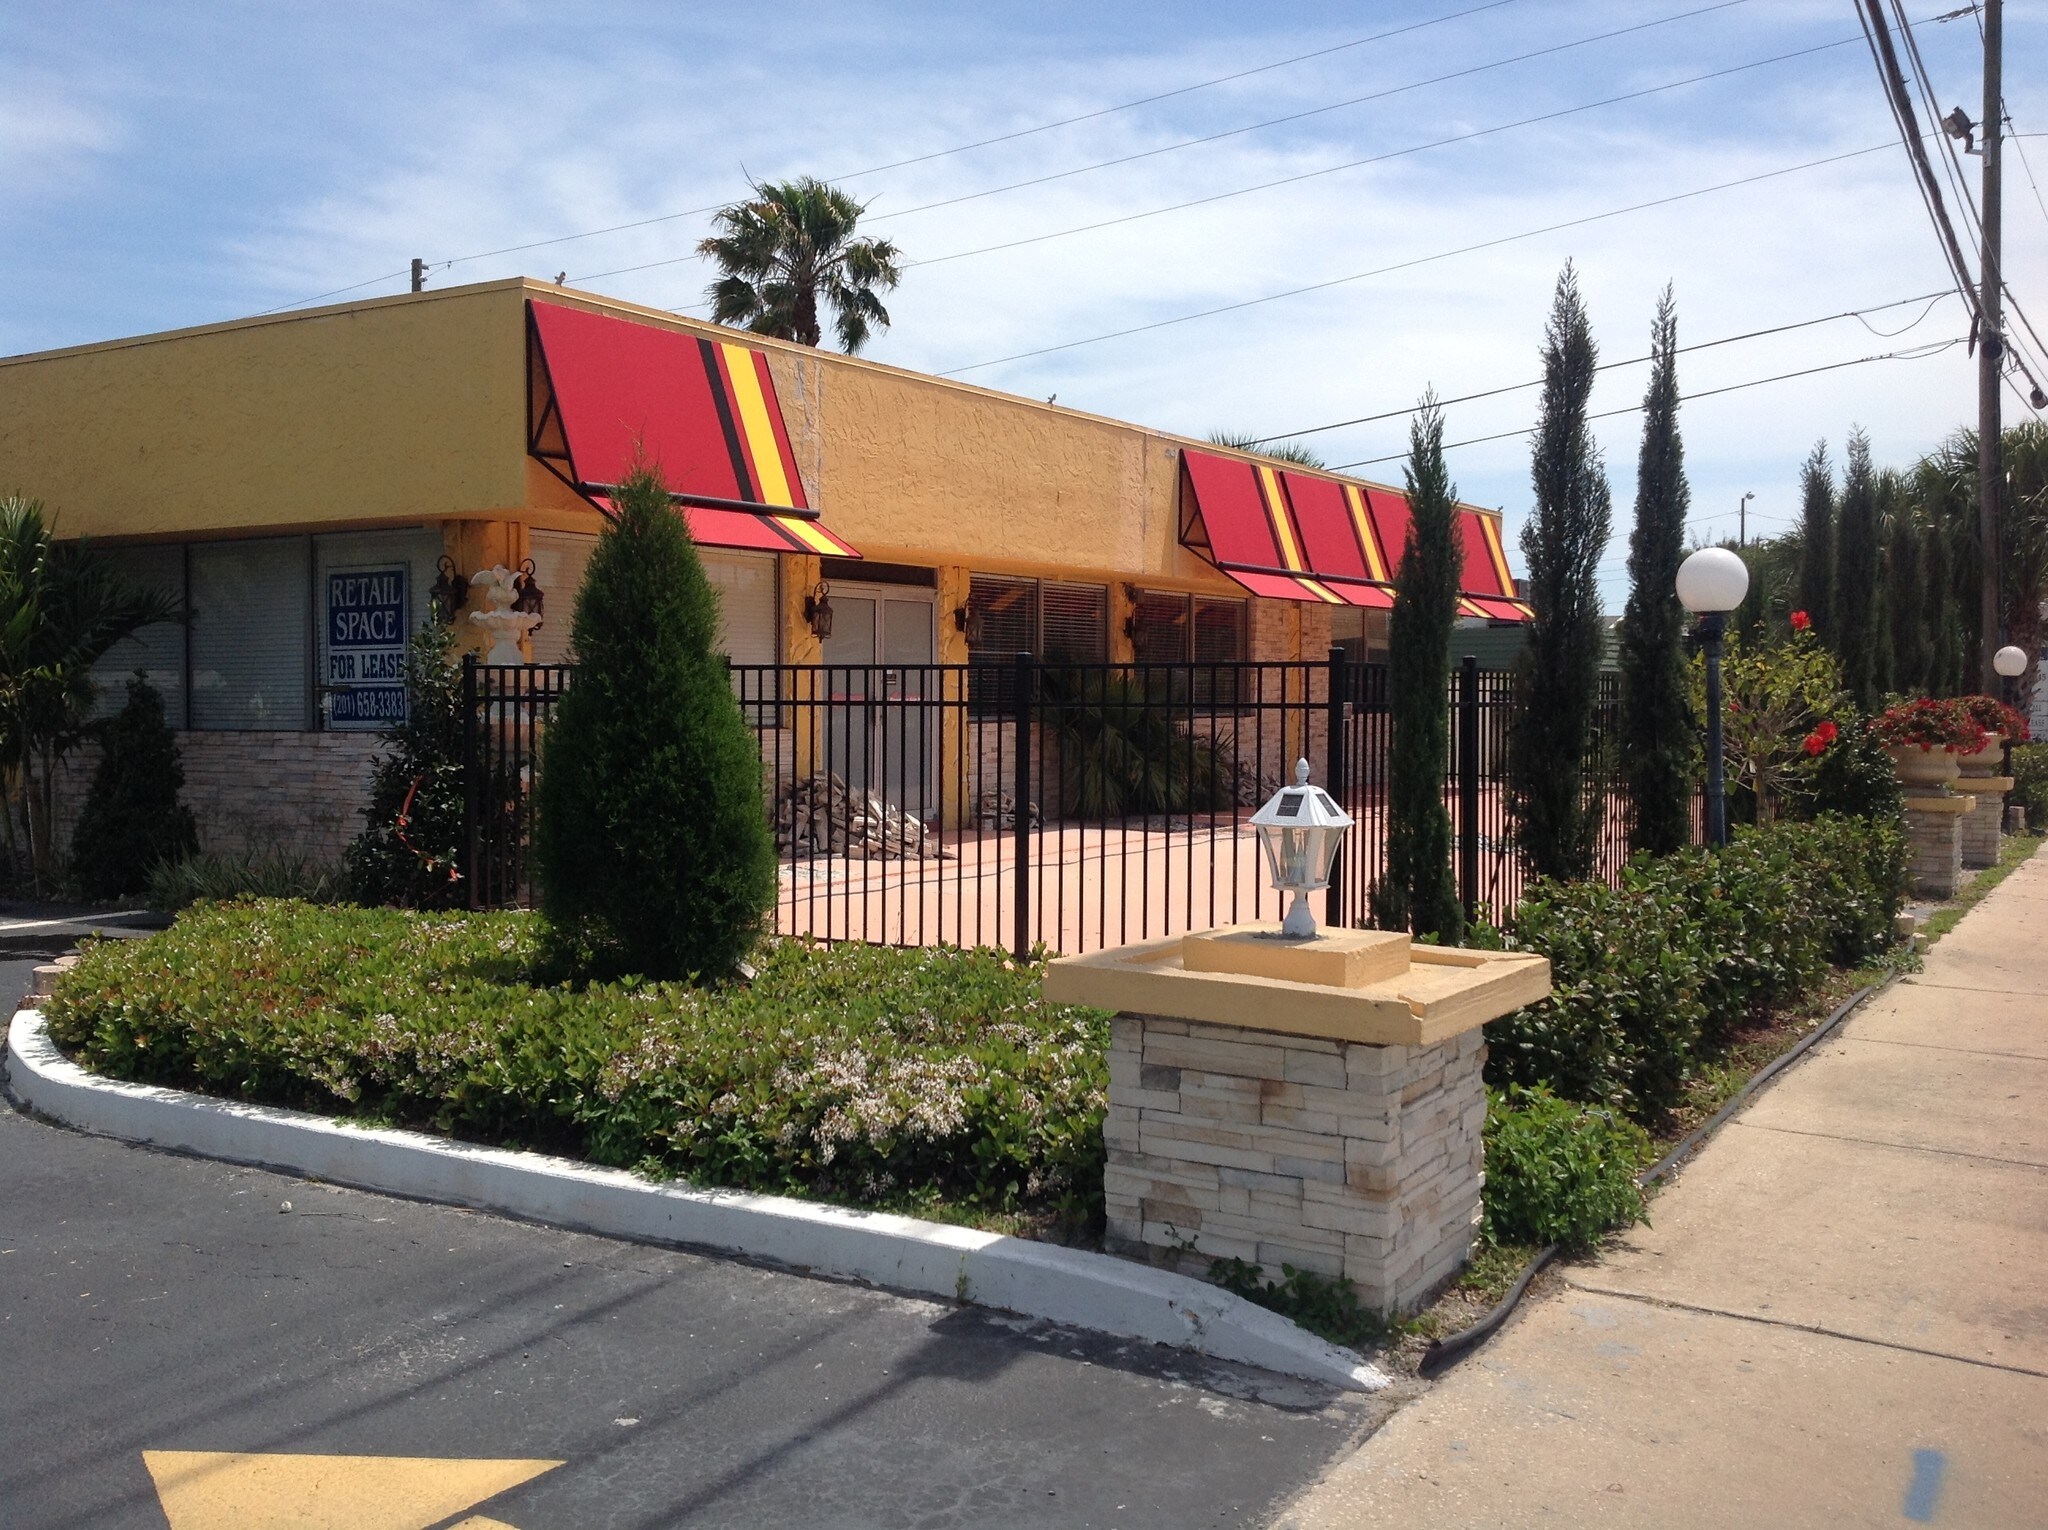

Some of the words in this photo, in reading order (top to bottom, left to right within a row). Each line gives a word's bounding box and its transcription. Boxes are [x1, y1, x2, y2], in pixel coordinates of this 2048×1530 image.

[332, 577, 401, 607] RETAIL
[337, 611, 397, 641] SPACE
[330, 655, 355, 680] FOR
[362, 653, 405, 679] LEASE
[333, 694, 356, 717] (201)
[357, 691, 404, 717] 658-3383
